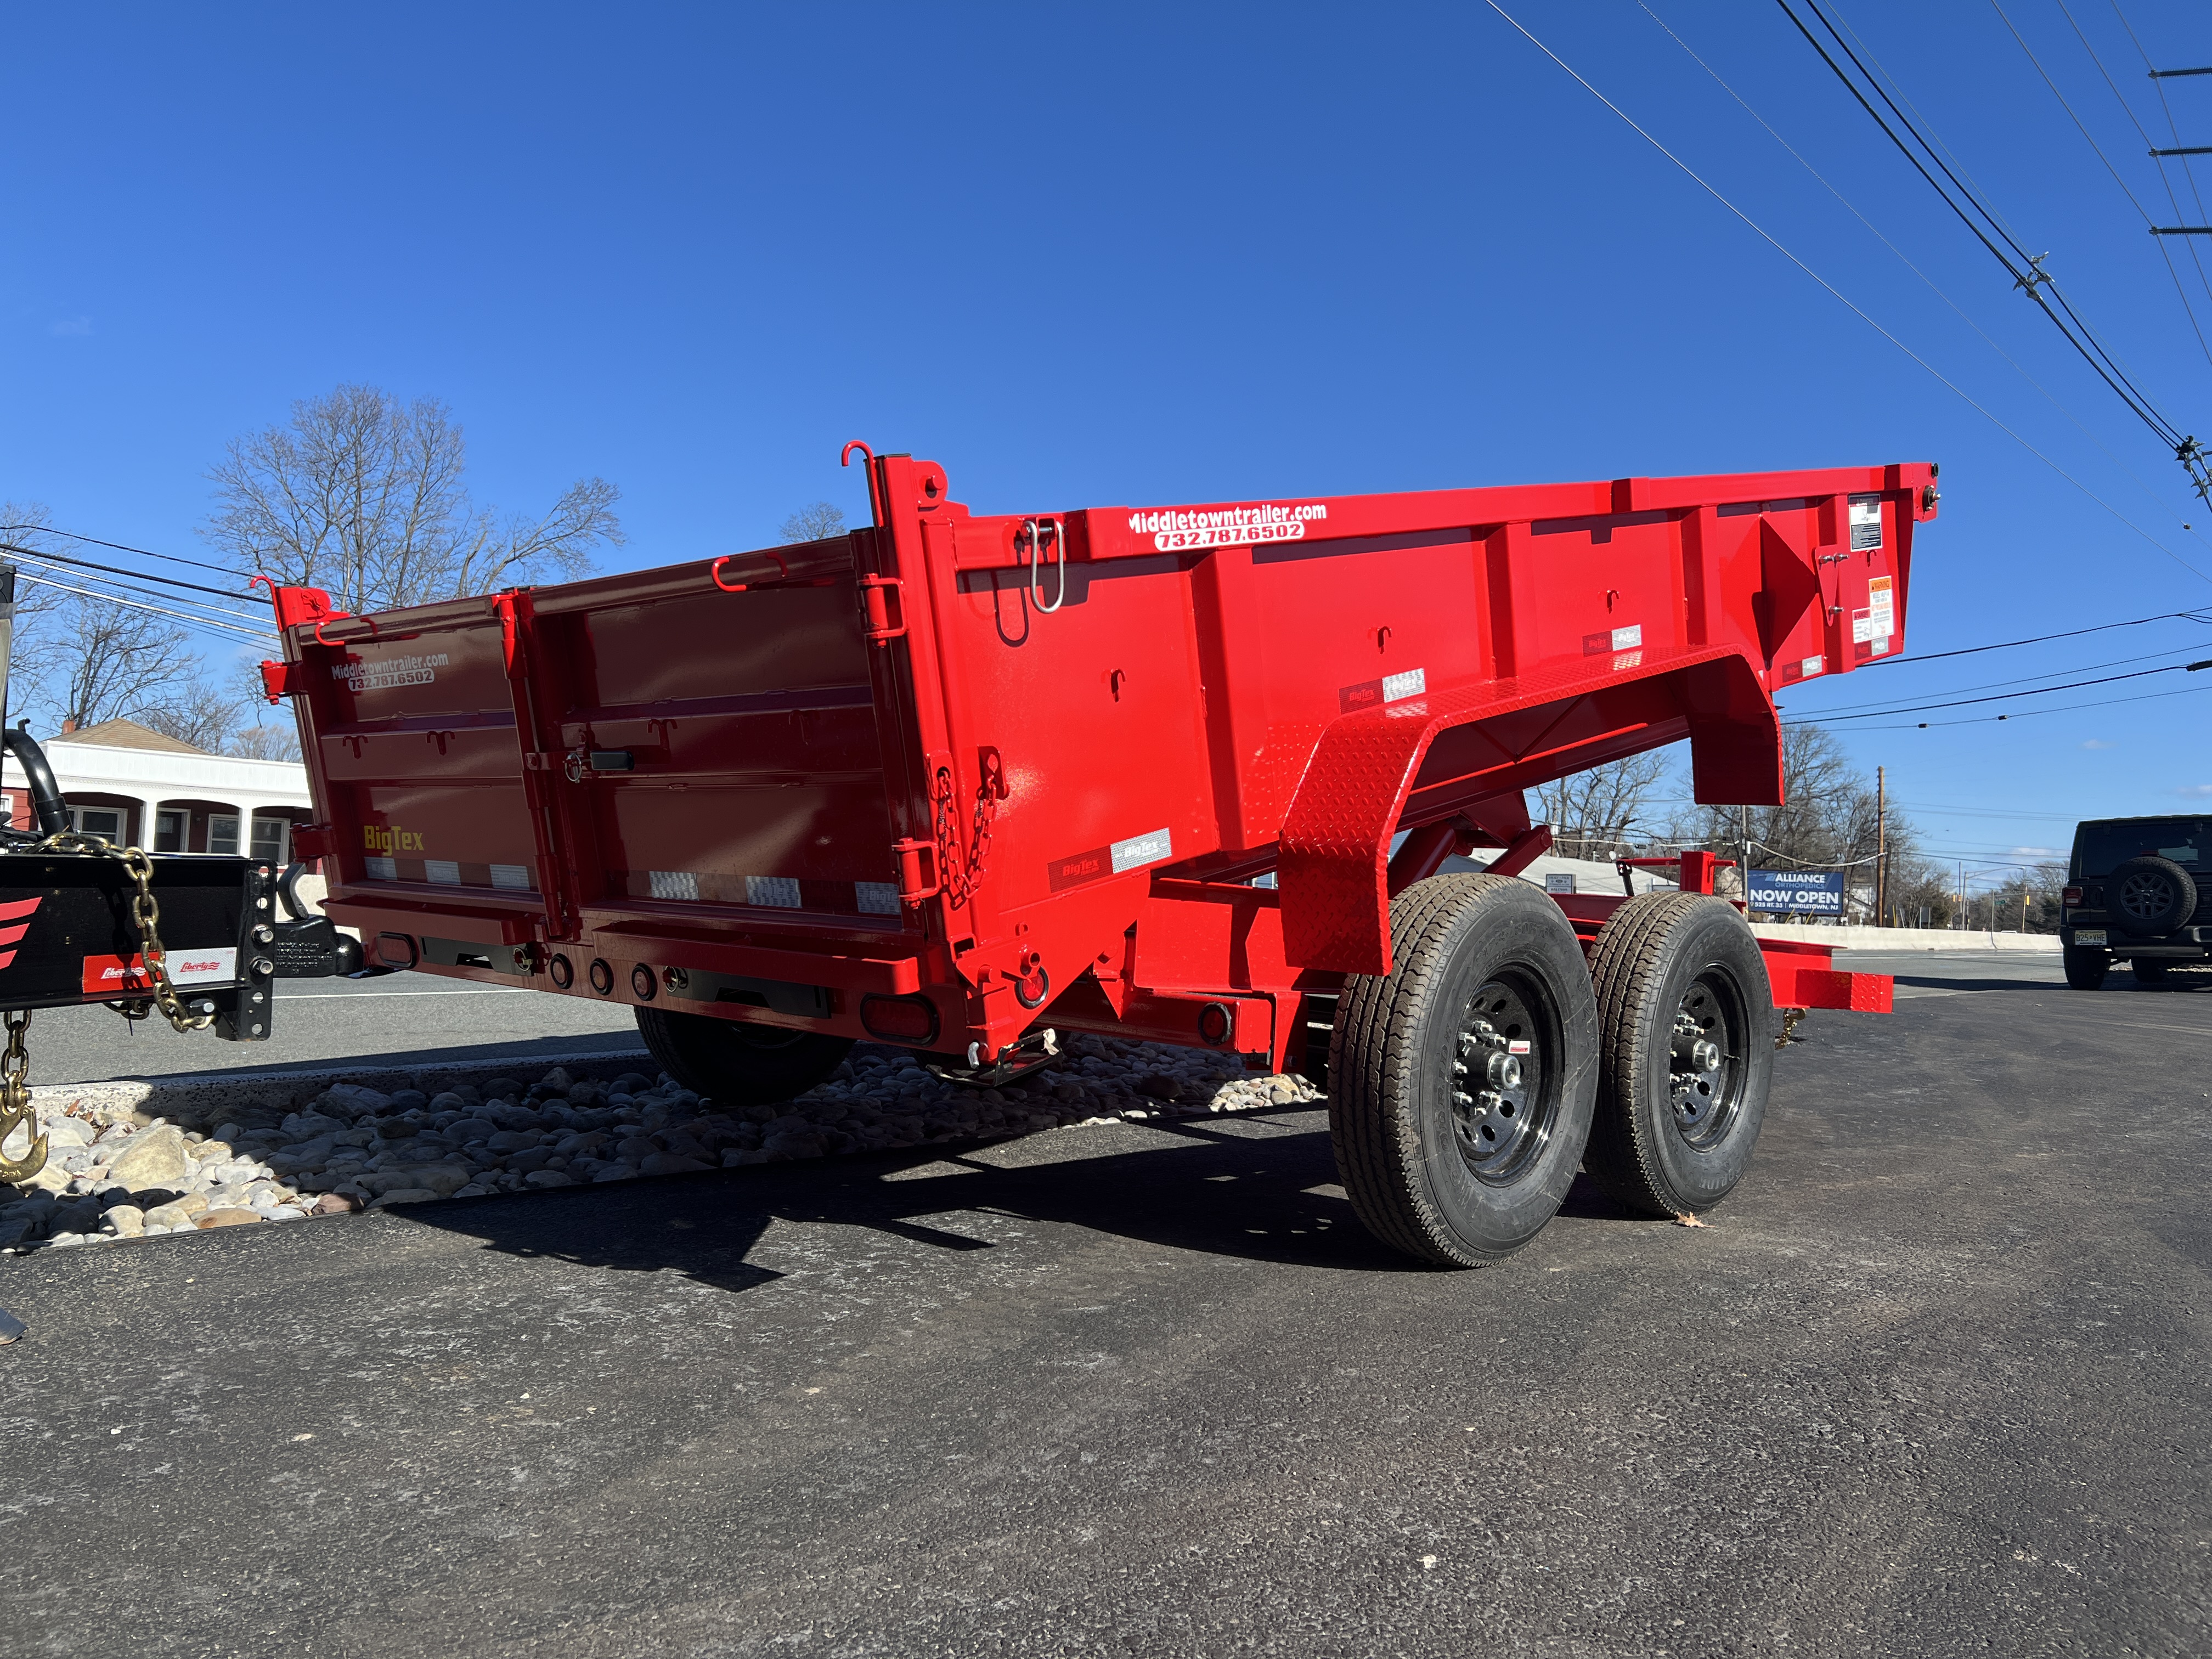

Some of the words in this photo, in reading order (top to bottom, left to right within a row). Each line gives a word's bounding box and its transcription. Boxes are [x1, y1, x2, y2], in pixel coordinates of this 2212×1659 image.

[1128, 504, 1327, 534] Middletowntrailer.com
[1158, 523, 1301, 549] 732.787.6502
[331, 653, 449, 680] Middletowntrailer.com
[350, 670, 433, 690] 732.787.6502
[364, 825, 424, 856] BigTex
[1125, 841, 1158, 857] BigTex
[1063, 858, 1099, 877] BigTex
[1775, 873, 1825, 883] ALLIANCE
[870, 890, 898, 905] BigTe
[1750, 889, 1792, 902] NOW
[1796, 890, 1838, 904] OPEN
[2076, 934, 2089, 942] B25
[180, 962, 209, 973] Liberty
